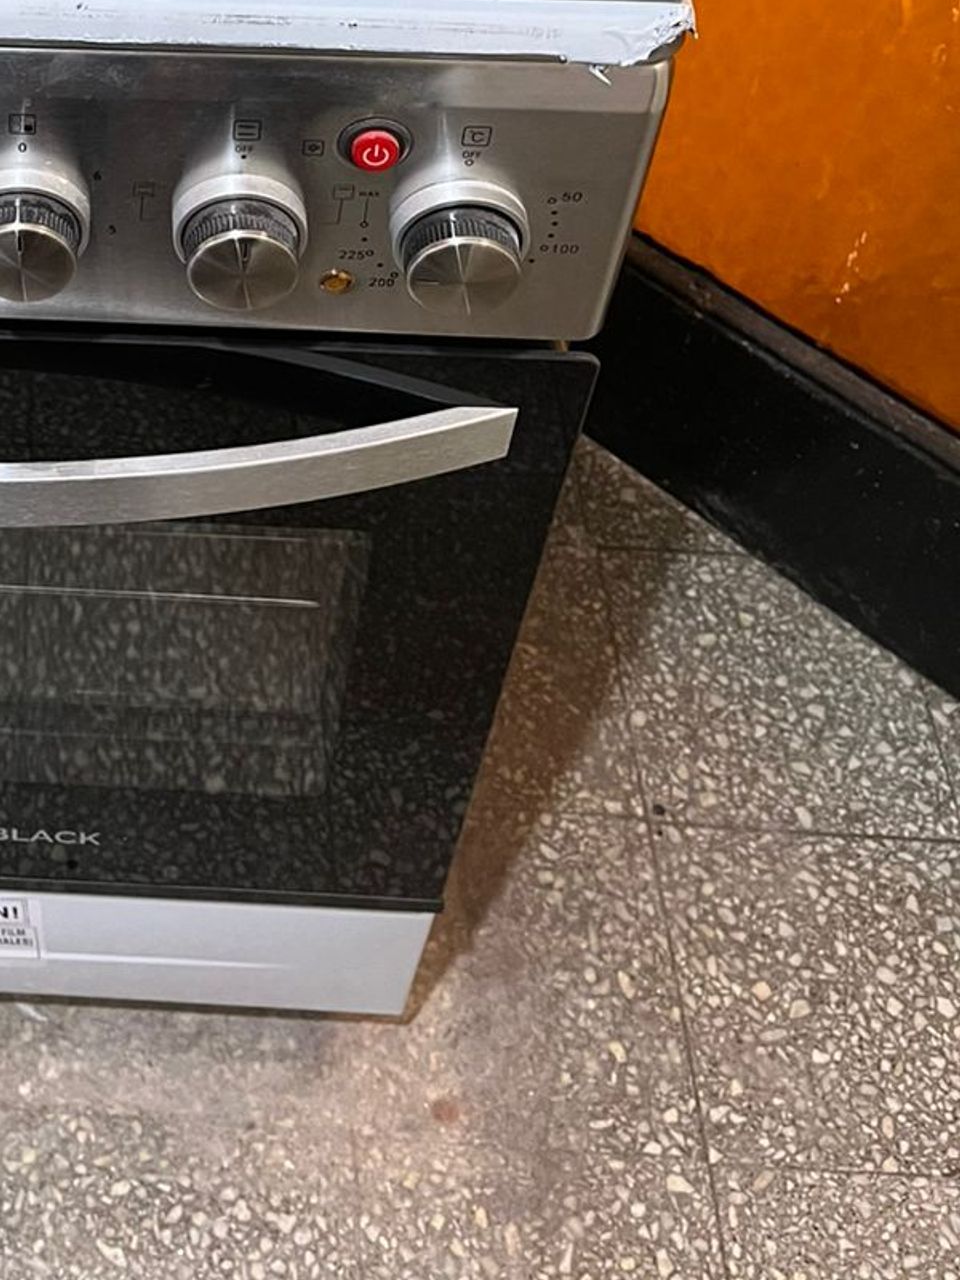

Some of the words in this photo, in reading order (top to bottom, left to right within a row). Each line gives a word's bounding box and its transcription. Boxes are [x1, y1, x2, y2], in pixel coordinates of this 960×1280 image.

[235, 145, 254, 153] OFF
[462, 150, 481, 159] OFF
[93, 170, 102, 181] 6
[562, 192, 583, 203] 50
[553, 244, 579, 254] 100
